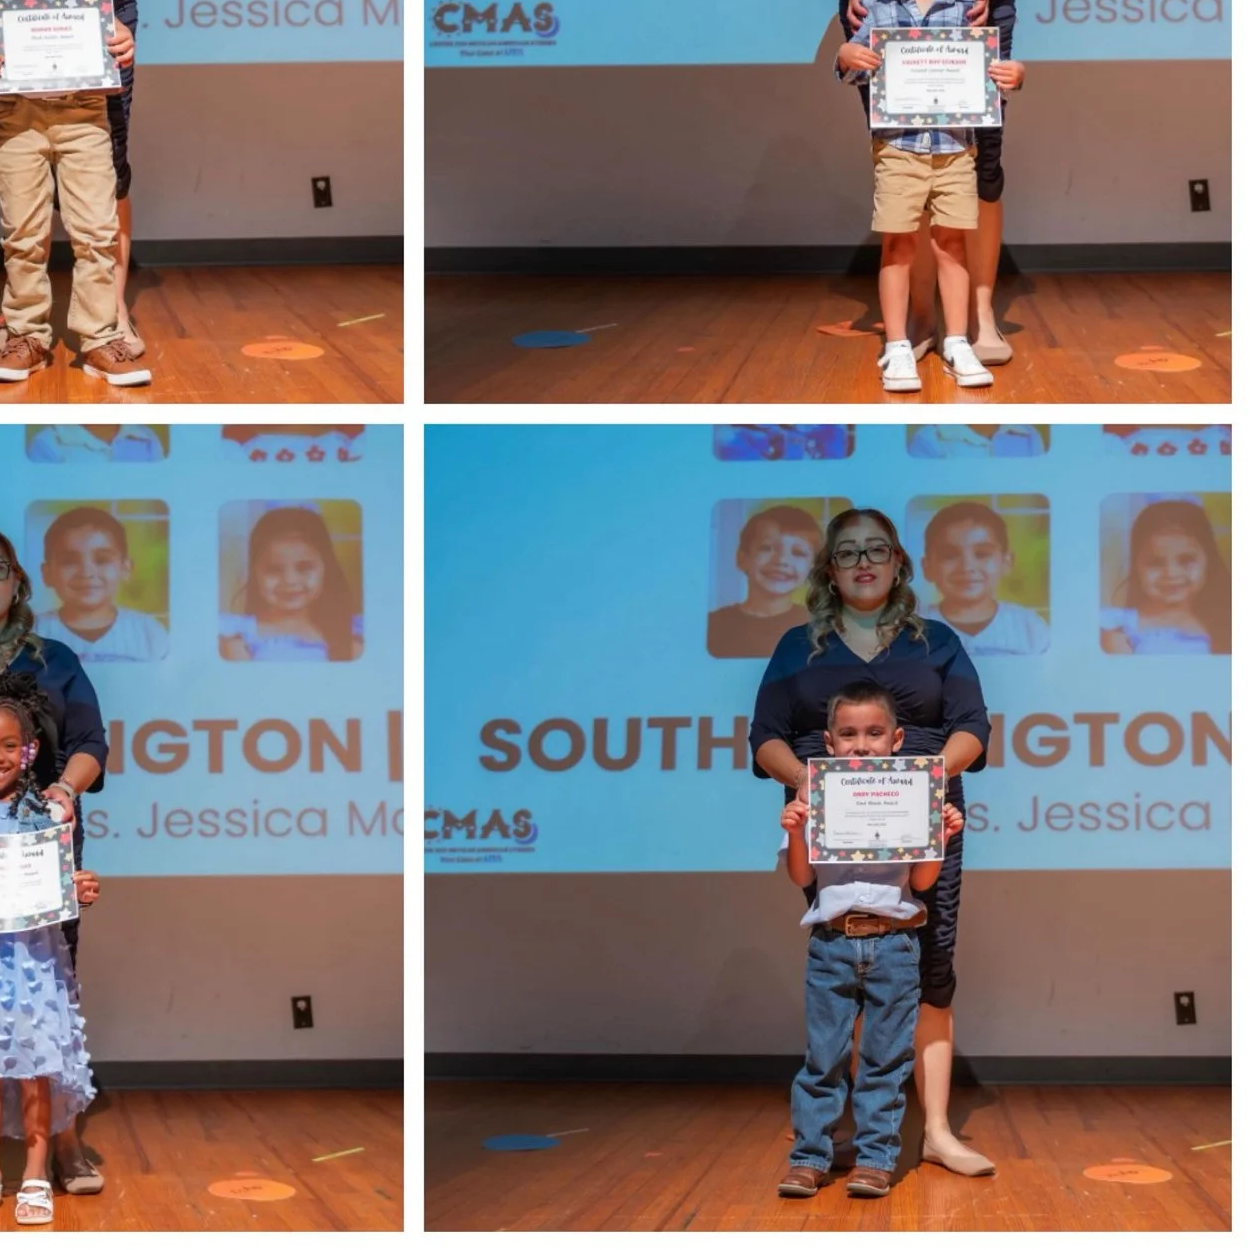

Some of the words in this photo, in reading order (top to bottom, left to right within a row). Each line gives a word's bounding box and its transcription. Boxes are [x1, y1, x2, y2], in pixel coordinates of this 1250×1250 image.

[432, 1, 558, 37] CMAS
[479, 715, 749, 772] SOUTH
[137, 800, 327, 839] Jessica
[1017, 793, 1211, 833] Jessica
